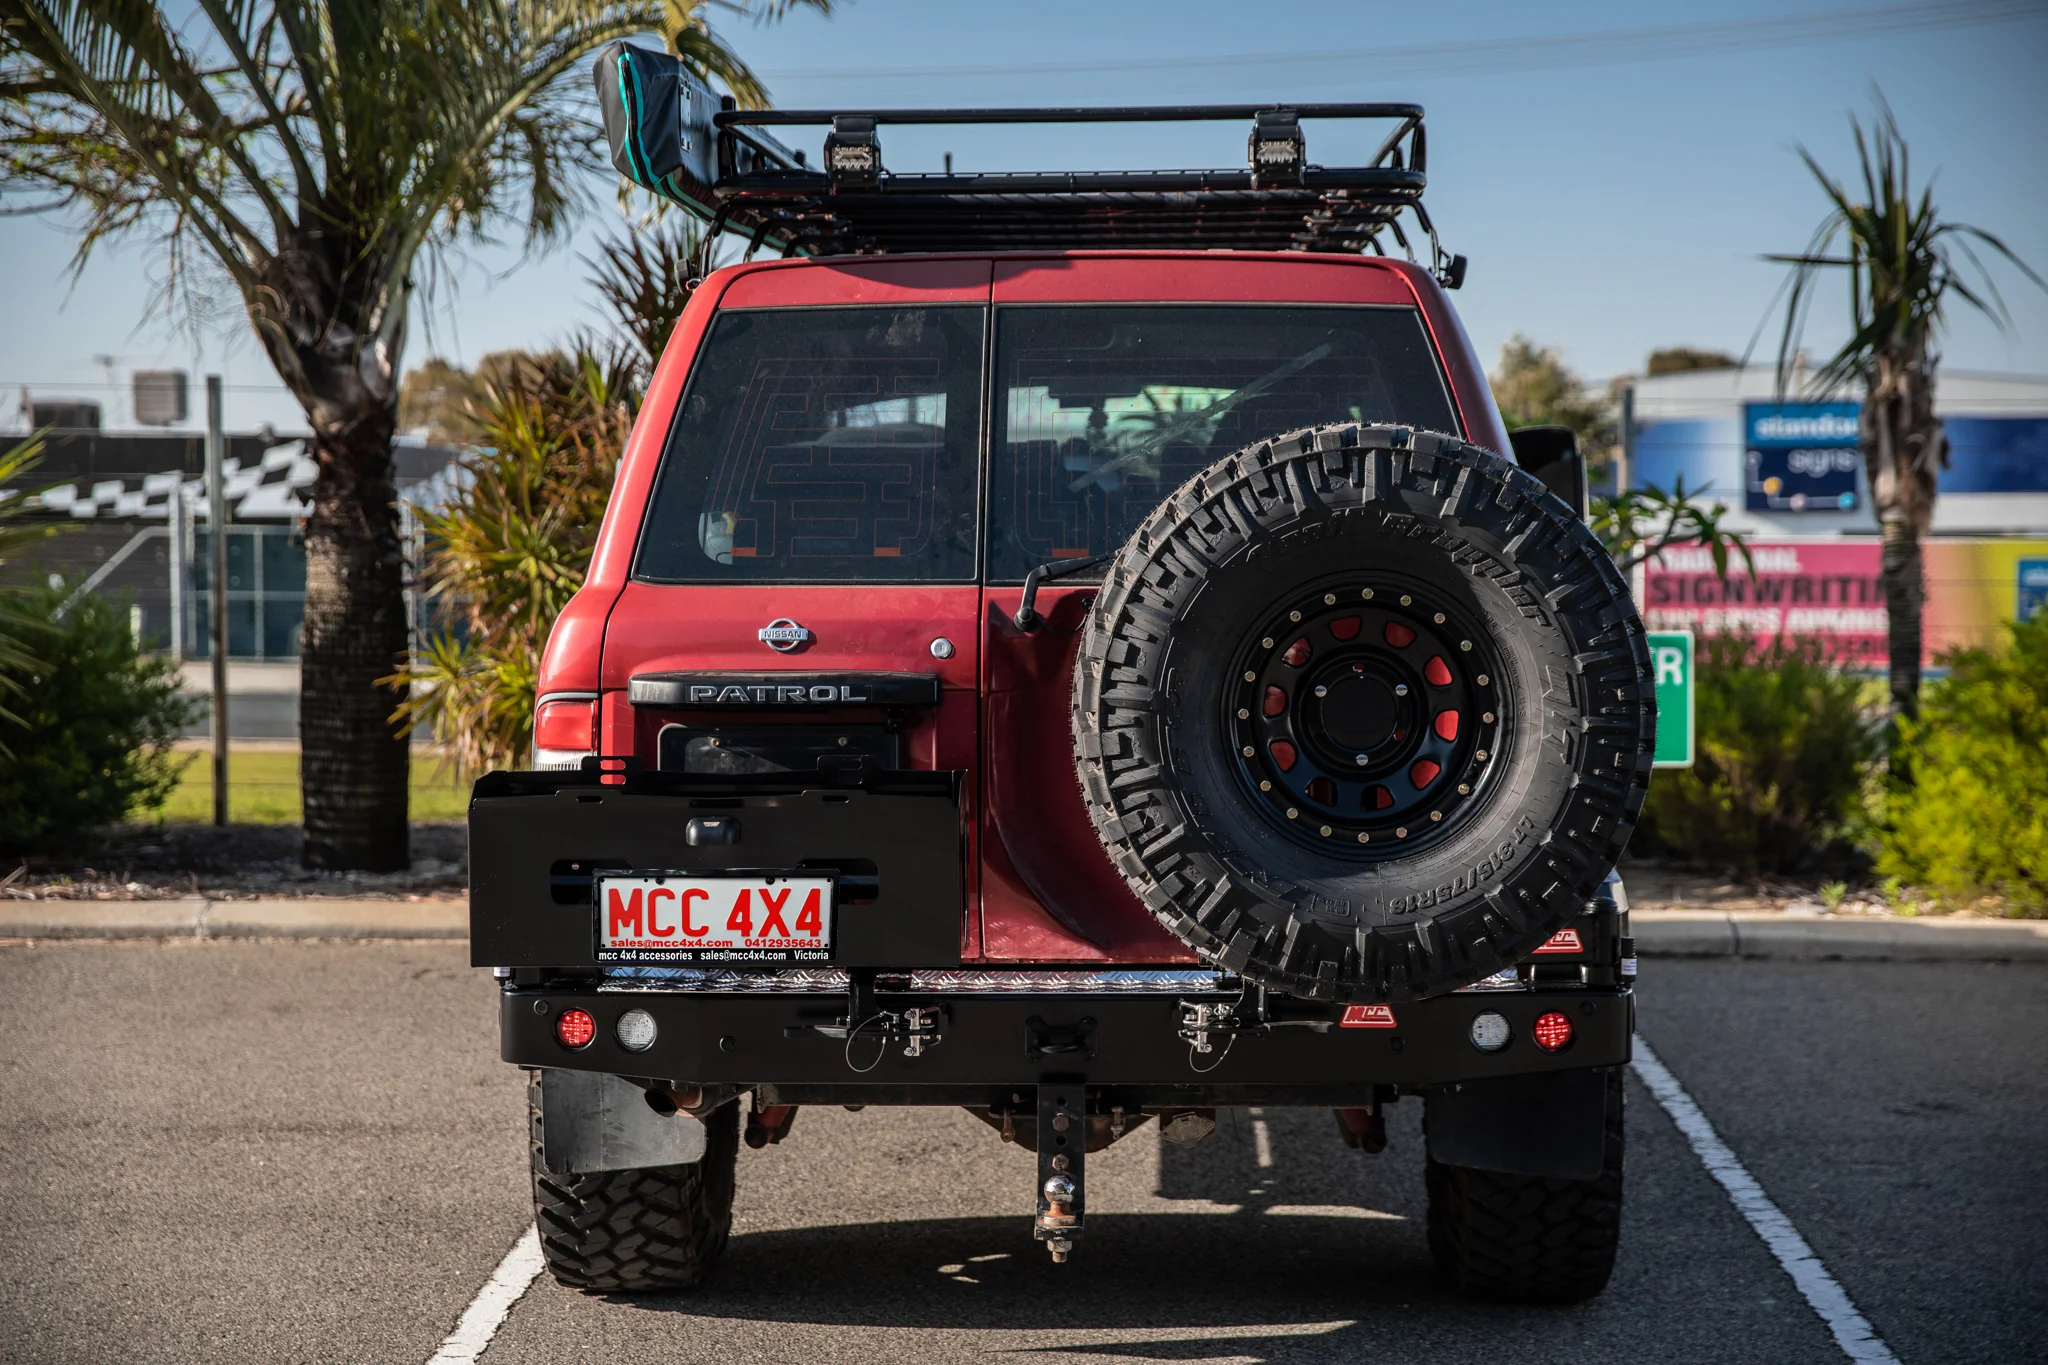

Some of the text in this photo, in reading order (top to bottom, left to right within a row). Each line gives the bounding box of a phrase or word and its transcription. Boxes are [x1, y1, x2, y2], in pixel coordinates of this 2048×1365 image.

[764, 630, 803, 639] NISSAN
[1651, 647, 1683, 685] R
[690, 685, 868, 702] PATROL
[1388, 839, 1516, 915] 315/75R16
[608, 888, 822, 938] MCC 4X4
[610, 938, 822, 949] sales@mcc4x4.com 0412935643
[598, 950, 829, 961] mcc 4x4 accessories sales@mcc4x4.com Victoria
